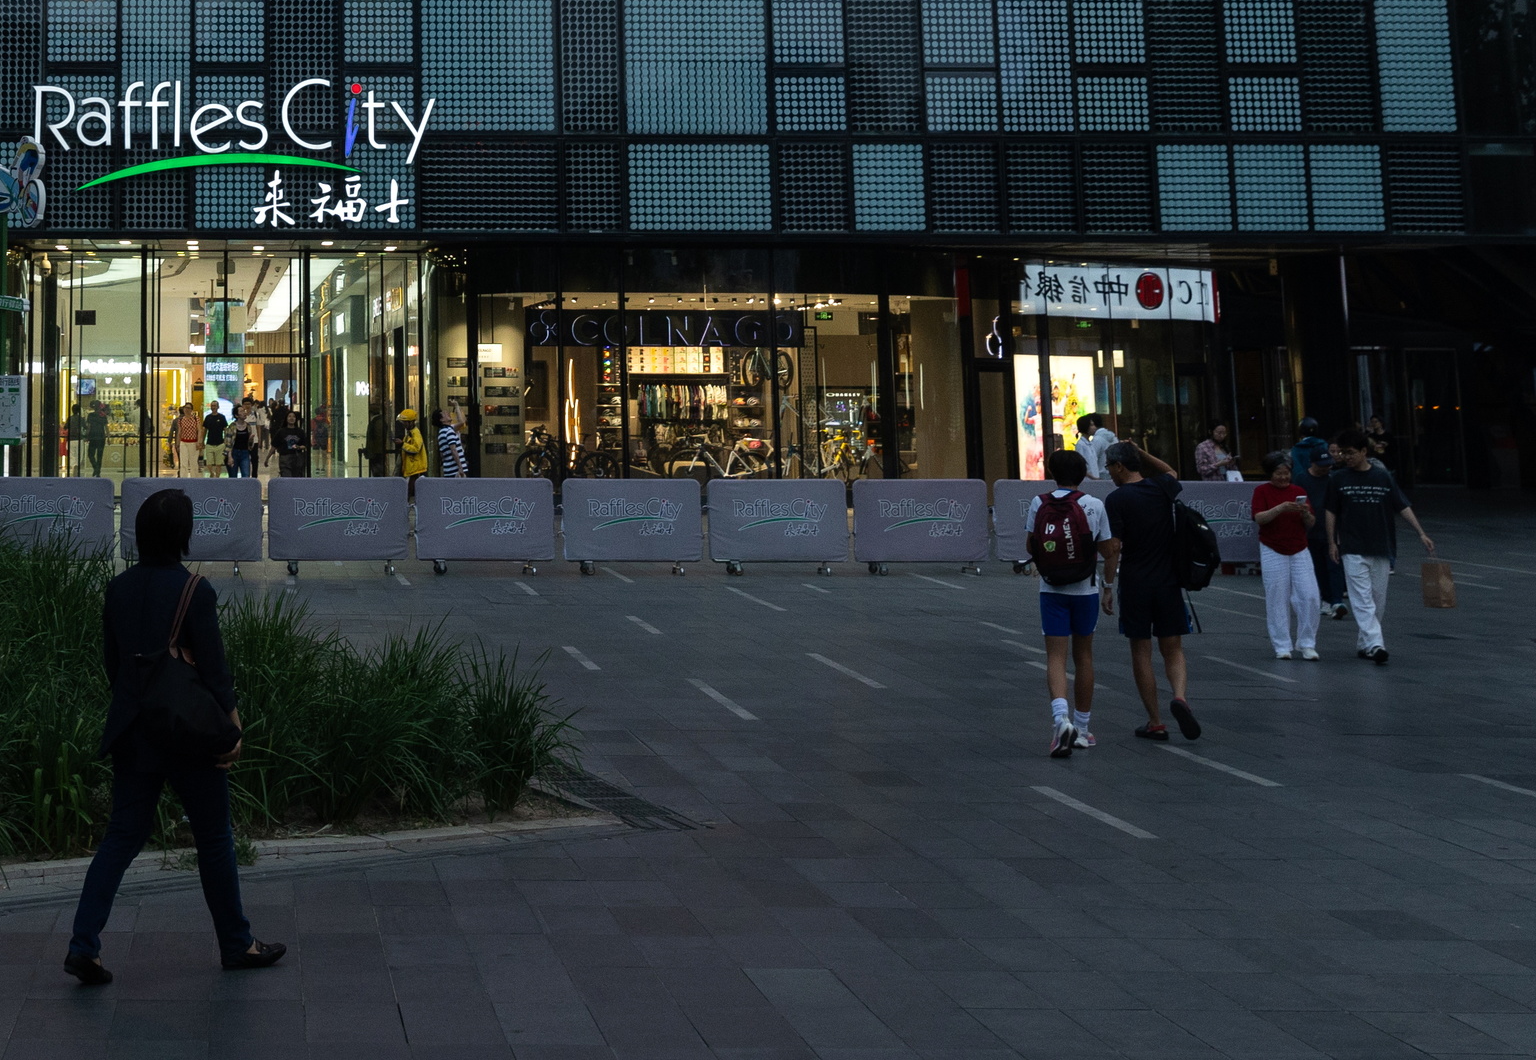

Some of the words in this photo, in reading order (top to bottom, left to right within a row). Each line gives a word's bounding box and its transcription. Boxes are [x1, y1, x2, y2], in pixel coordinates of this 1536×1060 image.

[32, 80, 269, 154] Raffles
[281, 78, 435, 165] City
[252, 169, 410, 228] 来福士
[571, 314, 793, 346] COLNAGO
[0, 495, 54, 514] Raffles
[56, 495, 94, 519] City
[203, 496, 241, 520] City
[293, 497, 349, 517] Raffles
[351, 497, 389, 522] City
[440, 496, 497, 516] Raffles
[498, 496, 535, 519] City
[587, 497, 644, 517] Raffles
[645, 497, 683, 521] City
[732, 498, 788, 518] Raffles
[789, 497, 828, 522] City
[878, 498, 934, 518] Raffles
[935, 497, 972, 522] City
[1224, 499, 1252, 520] Cit
[1062, 523, 1076, 560] KELME
